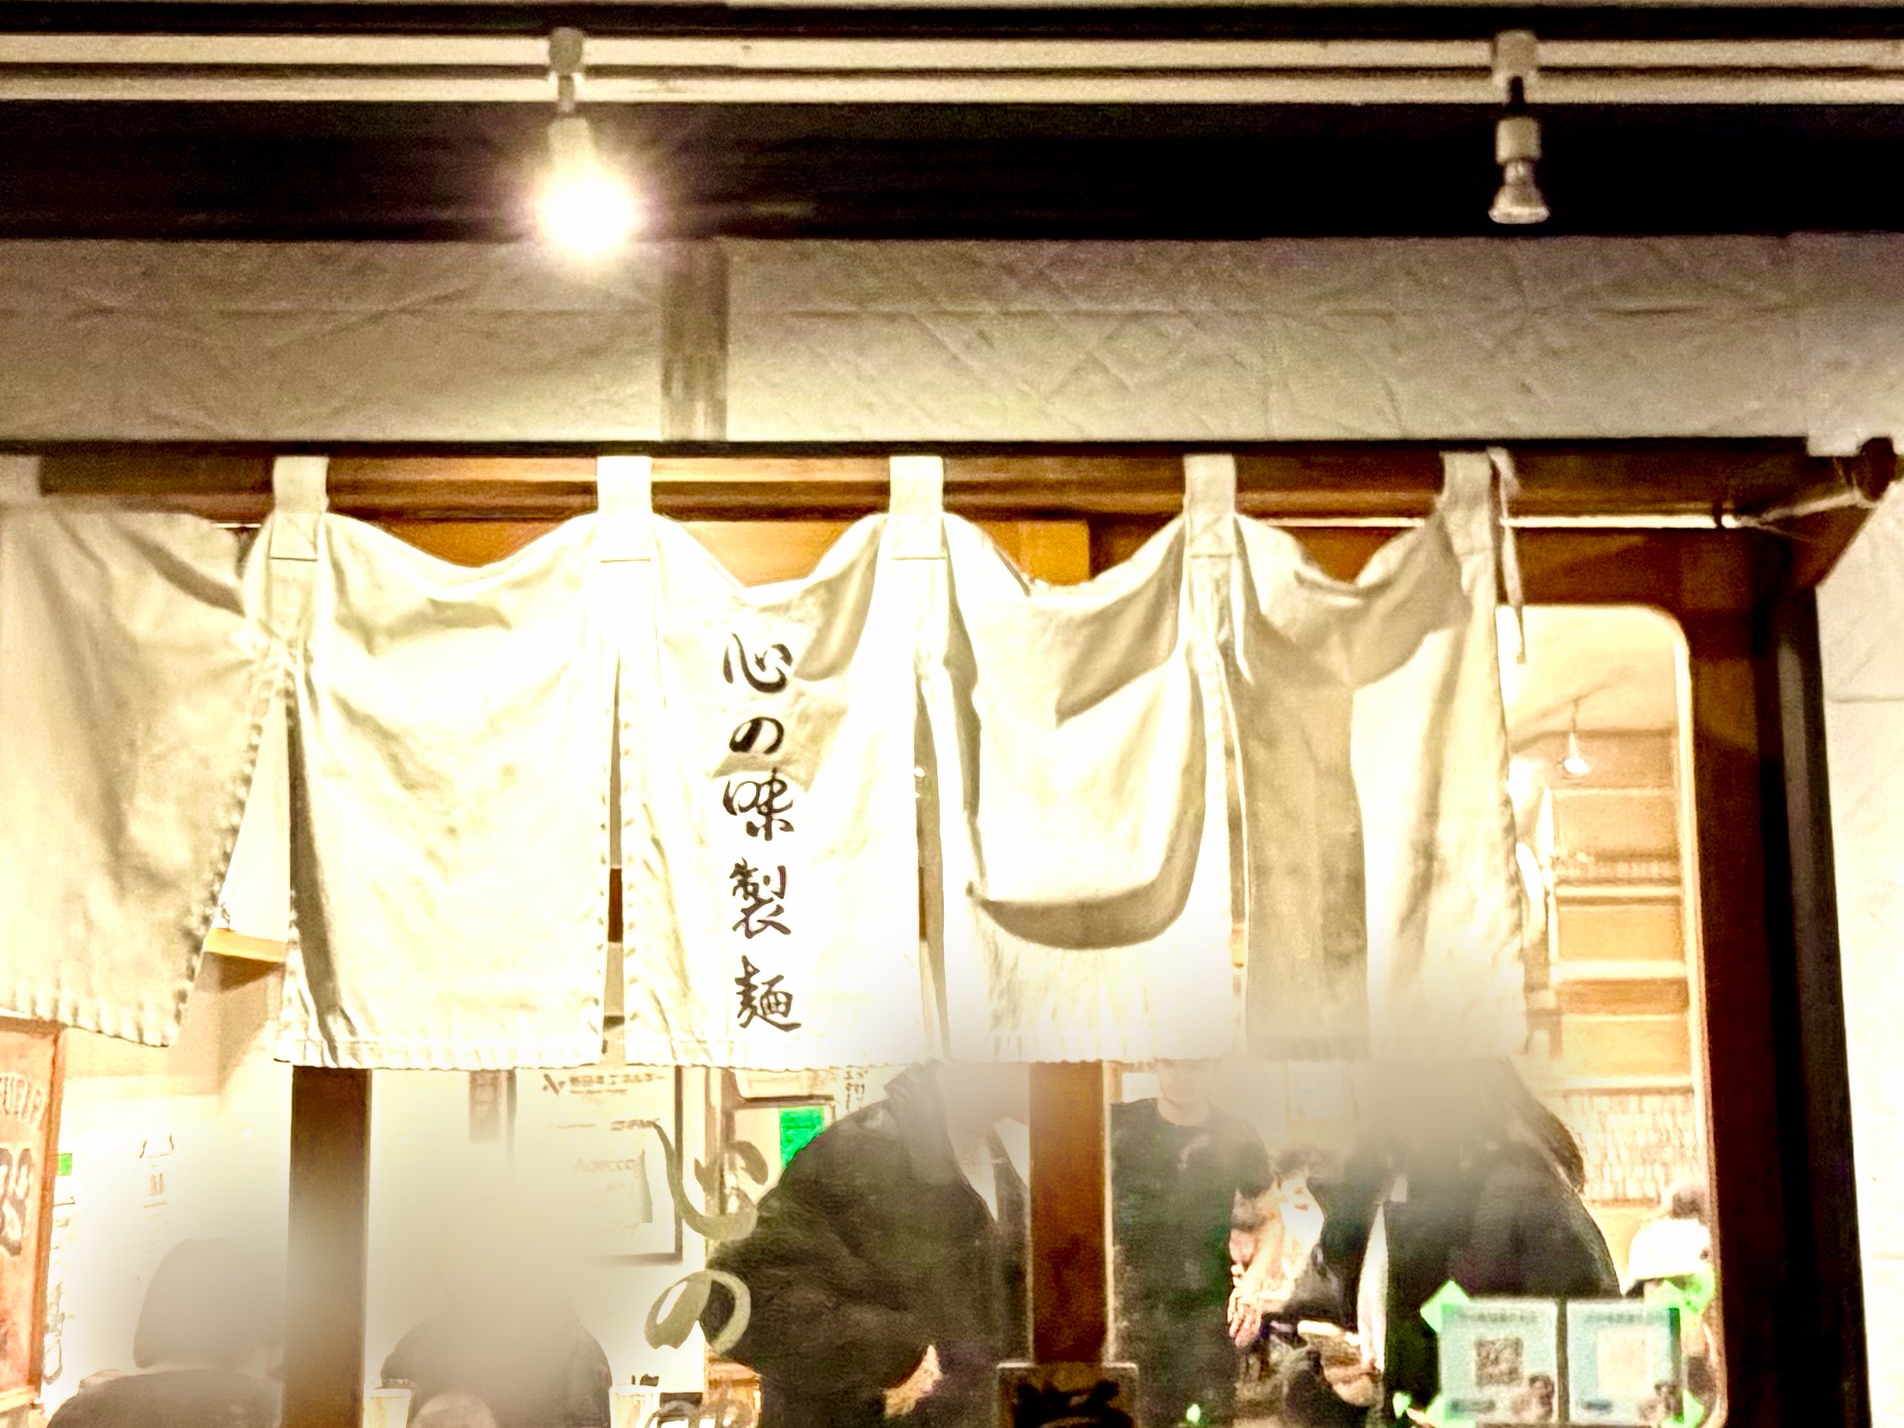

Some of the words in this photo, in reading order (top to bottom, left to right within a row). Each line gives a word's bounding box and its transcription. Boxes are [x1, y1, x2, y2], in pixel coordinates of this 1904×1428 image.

[720, 630, 804, 1034] 心の味製麺
